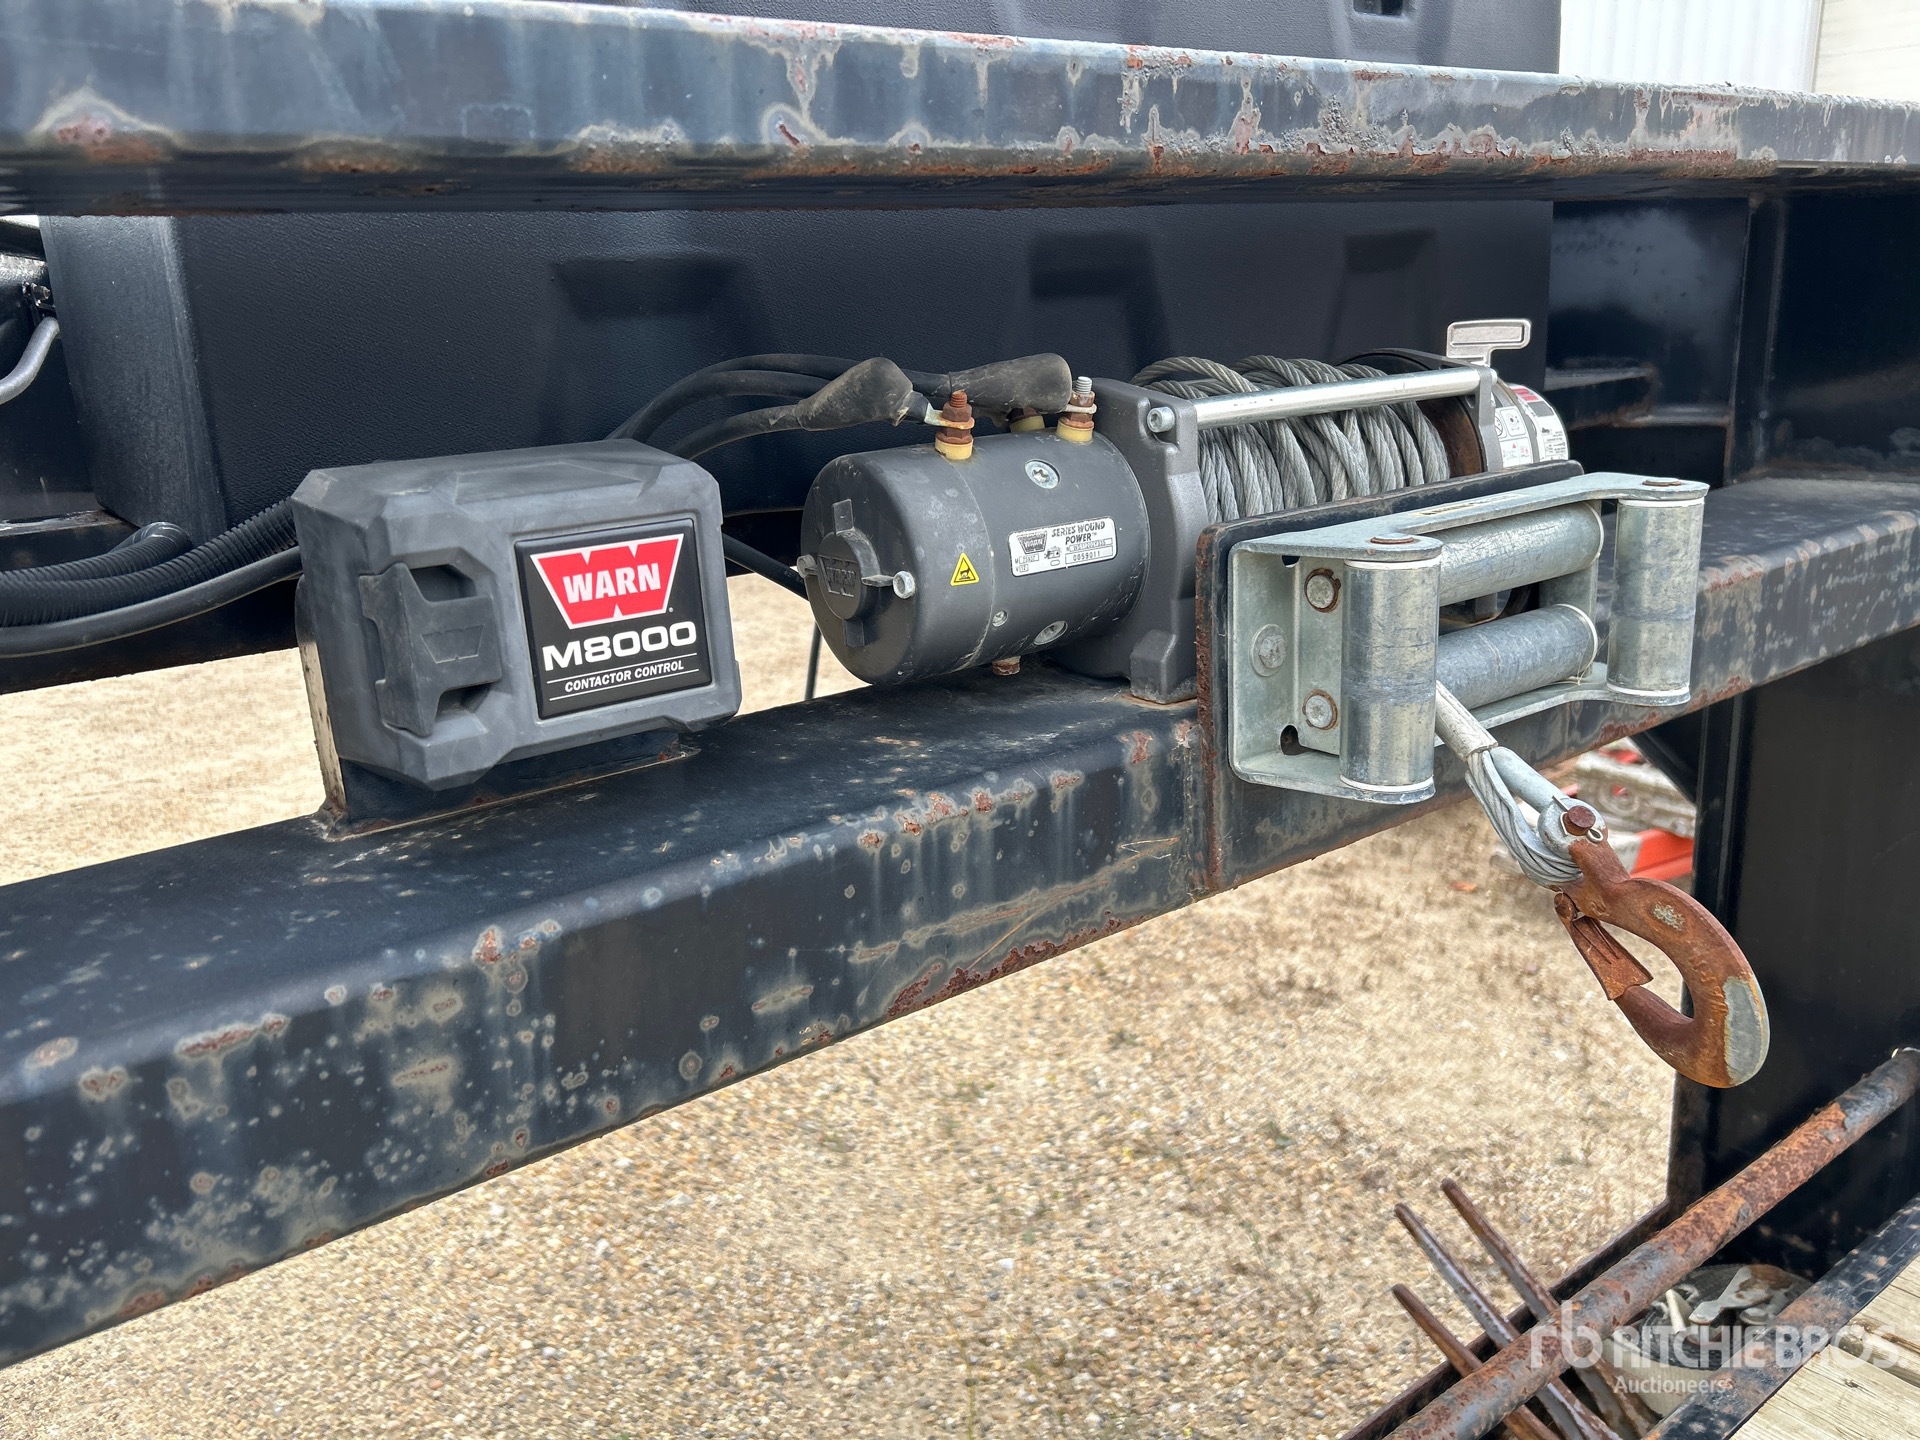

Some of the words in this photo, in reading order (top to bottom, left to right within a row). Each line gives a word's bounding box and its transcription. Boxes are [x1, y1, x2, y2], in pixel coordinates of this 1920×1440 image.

[1051, 525, 1076, 537] SERIES
[1077, 521, 1105, 533] WOUND
[562, 562, 662, 604] WARN
[542, 621, 697, 671] M8000
[564, 670, 632, 693] CONTACTOR
[634, 660, 685, 679] CONTROL
